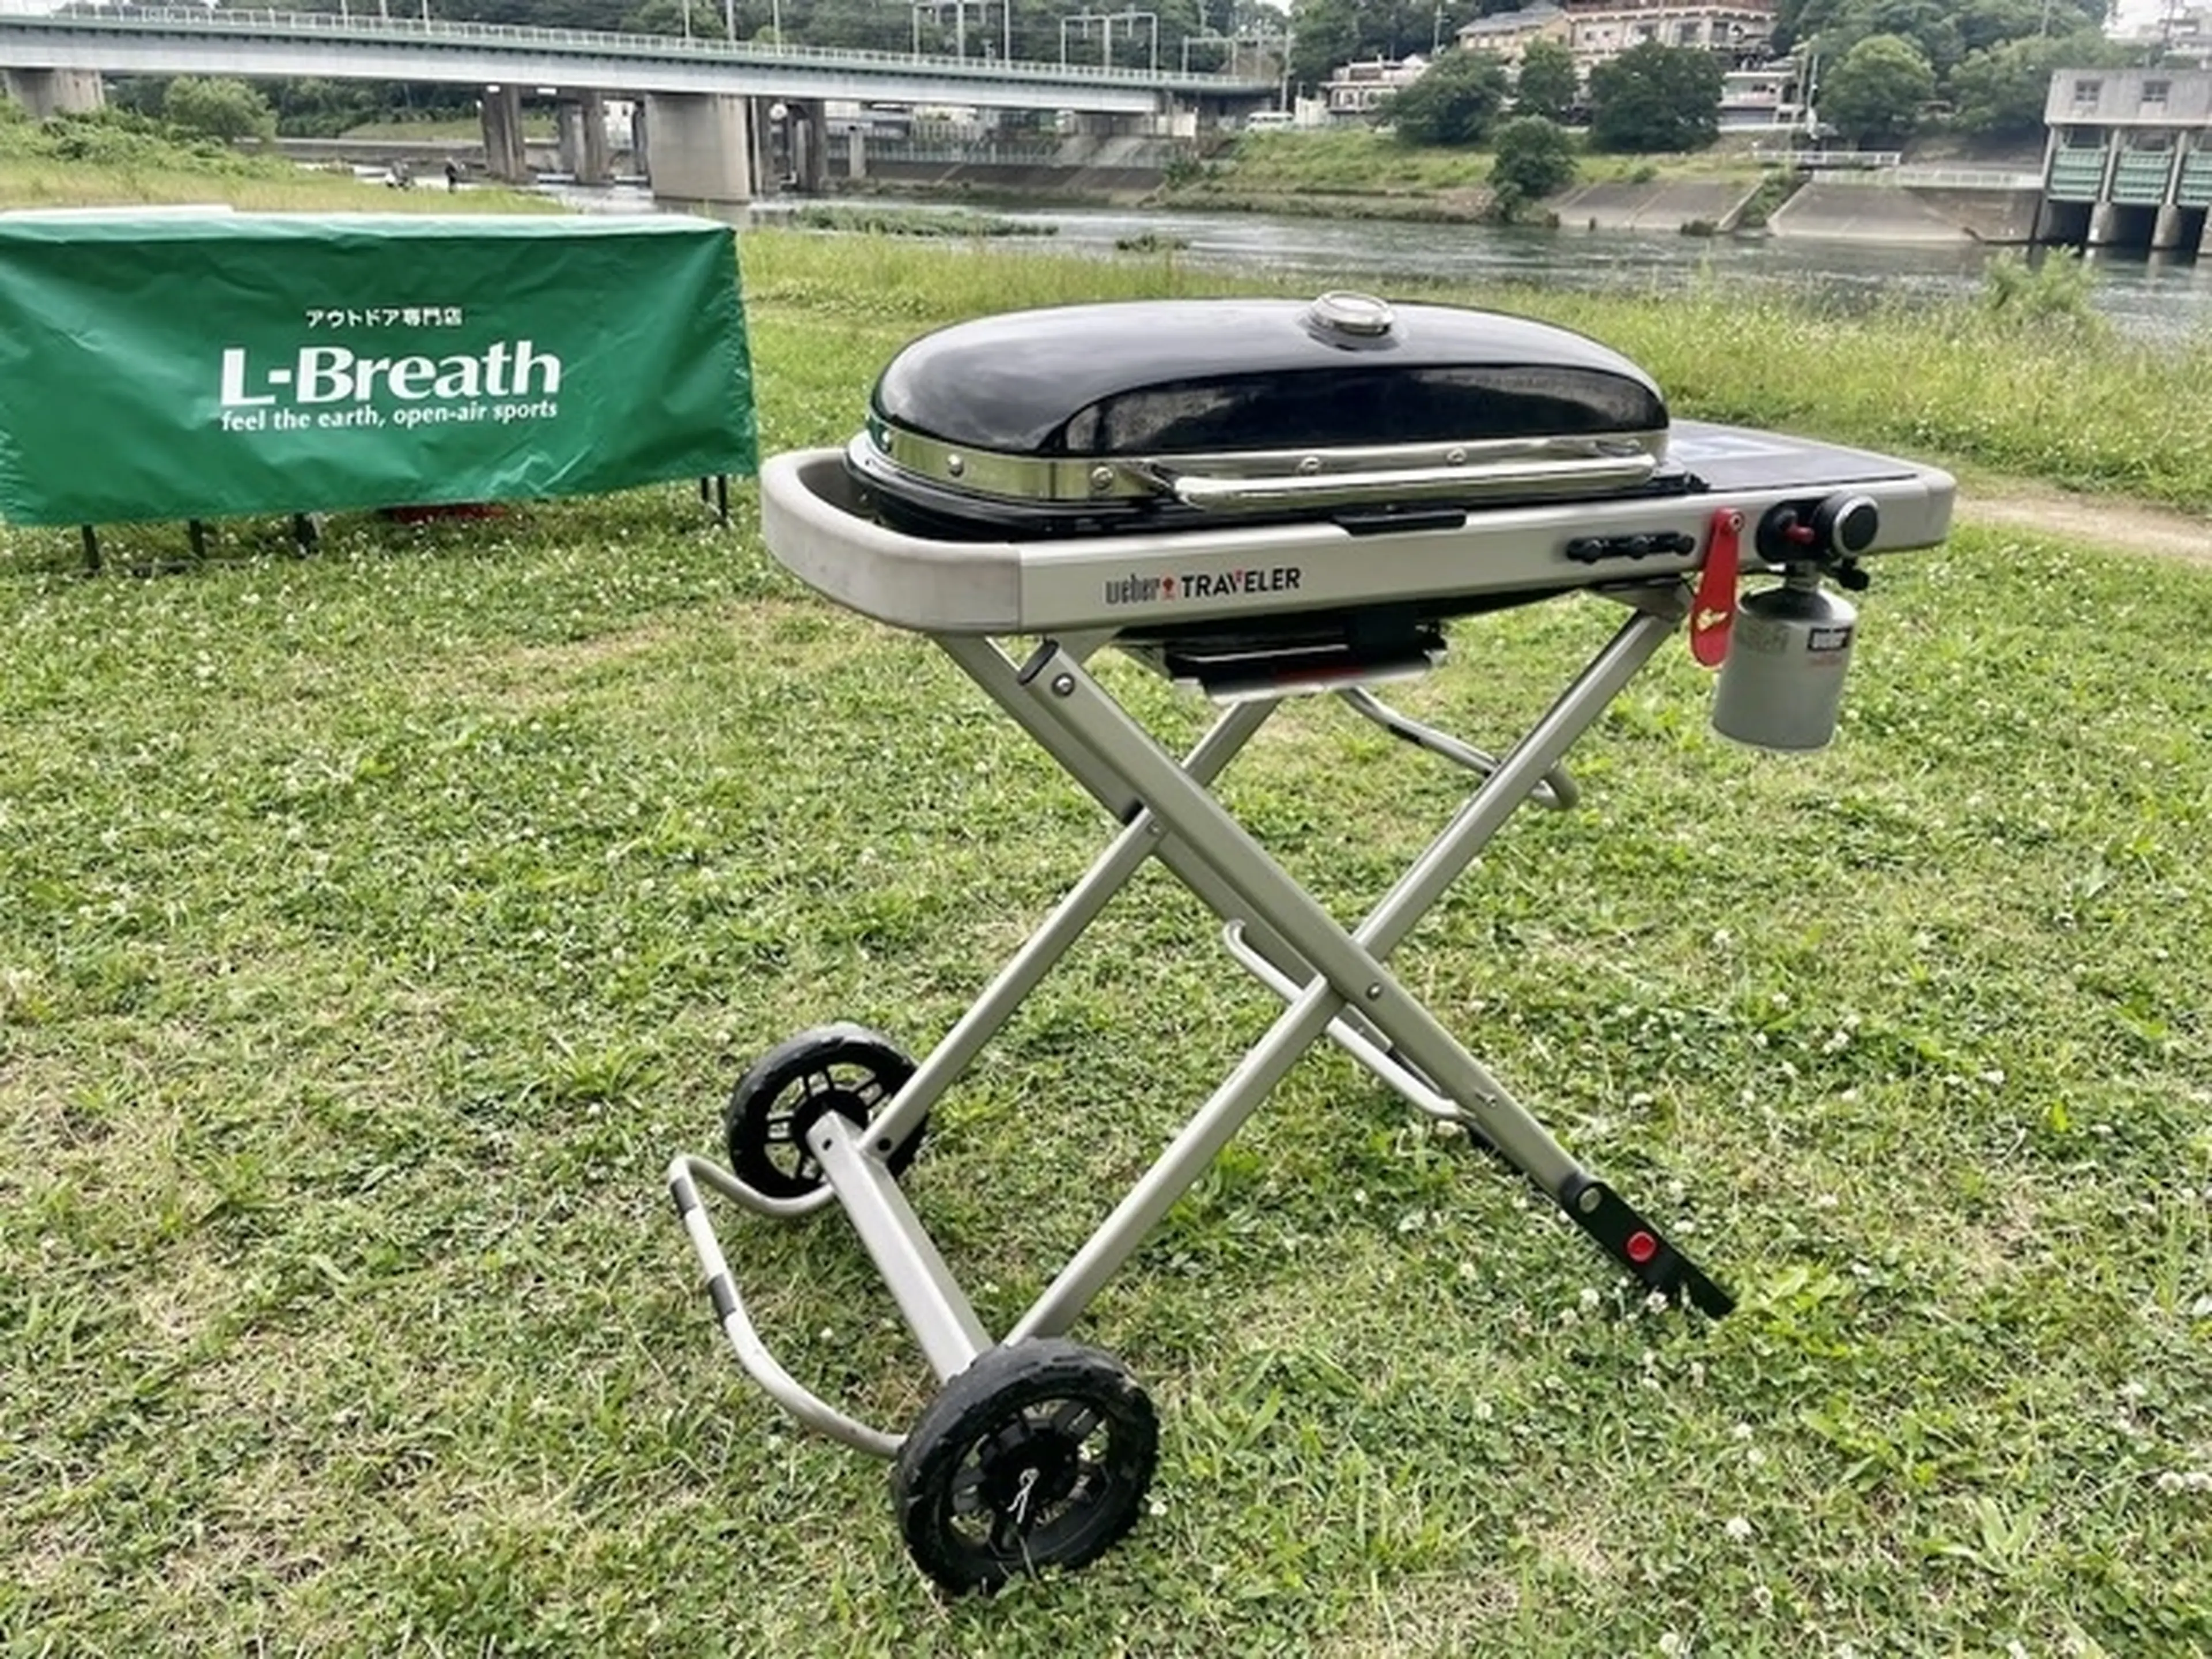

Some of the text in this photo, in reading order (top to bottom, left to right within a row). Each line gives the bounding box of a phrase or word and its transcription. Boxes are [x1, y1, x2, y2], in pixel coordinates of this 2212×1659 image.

[305, 307, 463, 327] アウトドア専門店
[220, 340, 562, 406] L-Breath
[221, 400, 557, 431] feel the earth, open-air sports
[1181, 567, 1301, 599] TRAVELER
